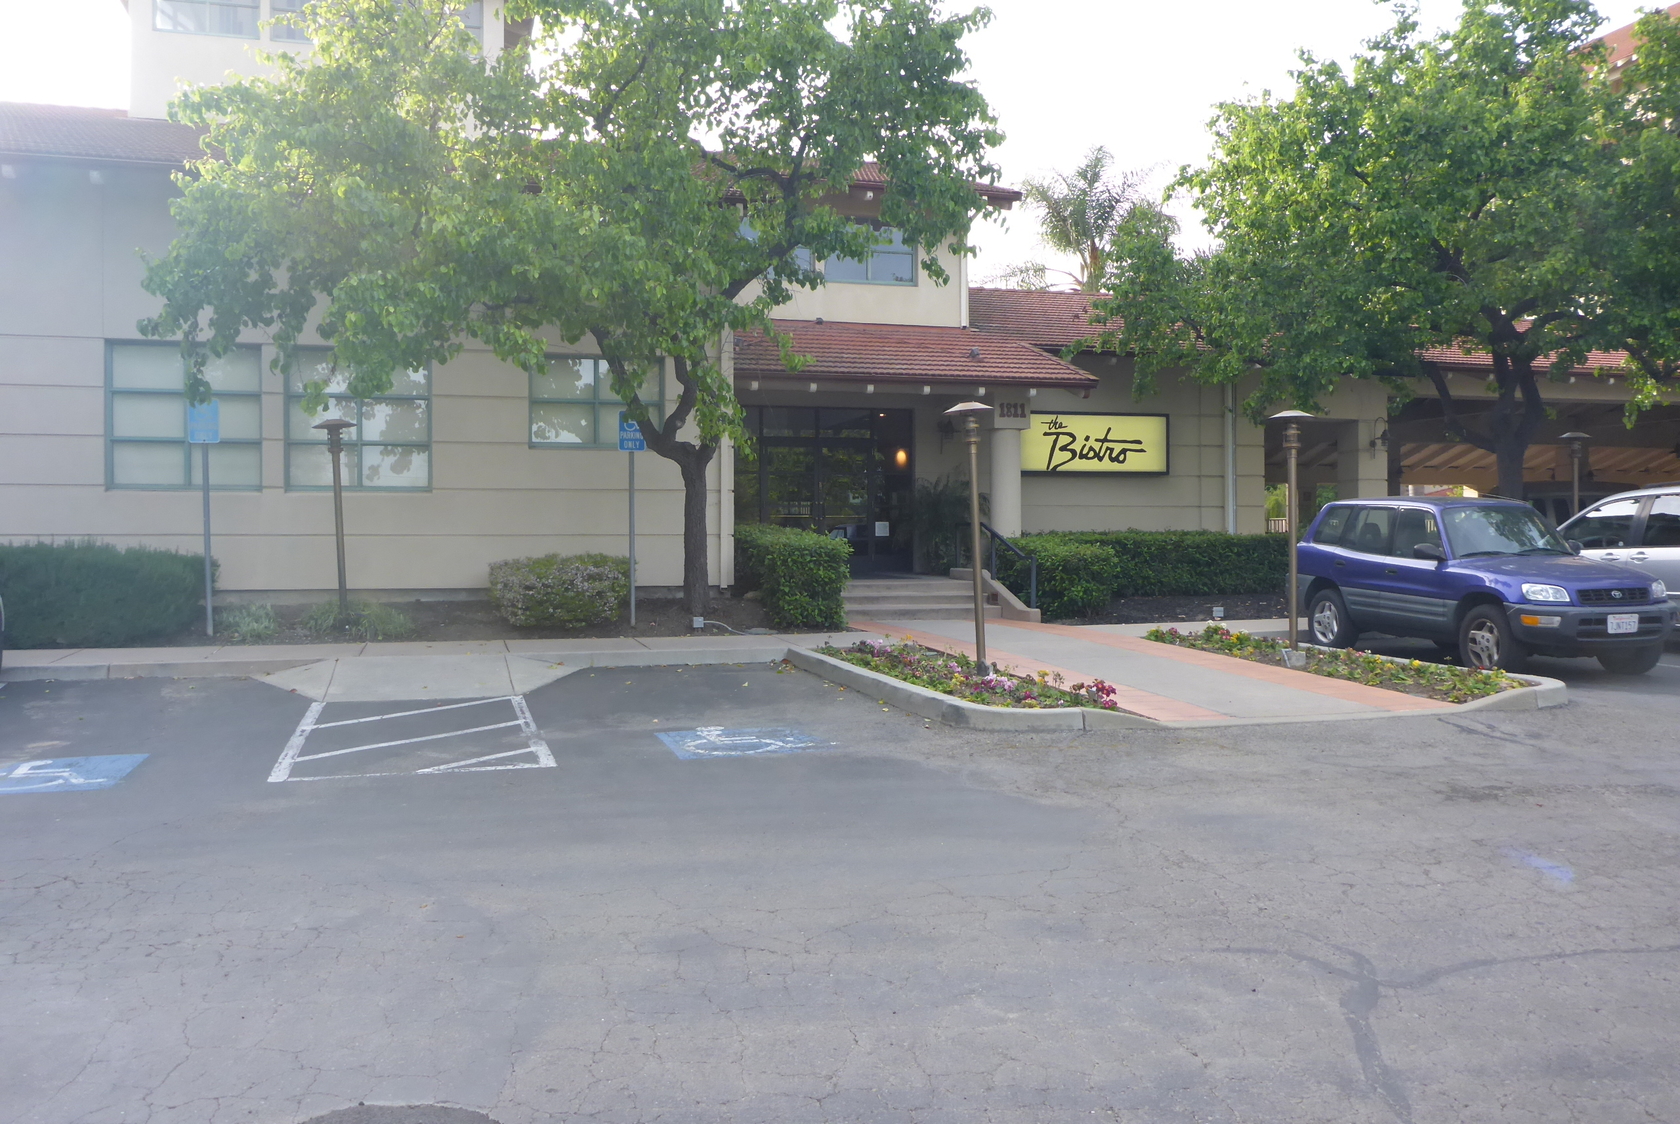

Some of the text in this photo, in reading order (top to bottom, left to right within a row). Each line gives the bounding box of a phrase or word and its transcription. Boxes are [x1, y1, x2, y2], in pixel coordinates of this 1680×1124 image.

[999, 403, 1026, 418] 1811
[1041, 415, 1068, 430] the
[1043, 427, 1147, 471] Bistro
